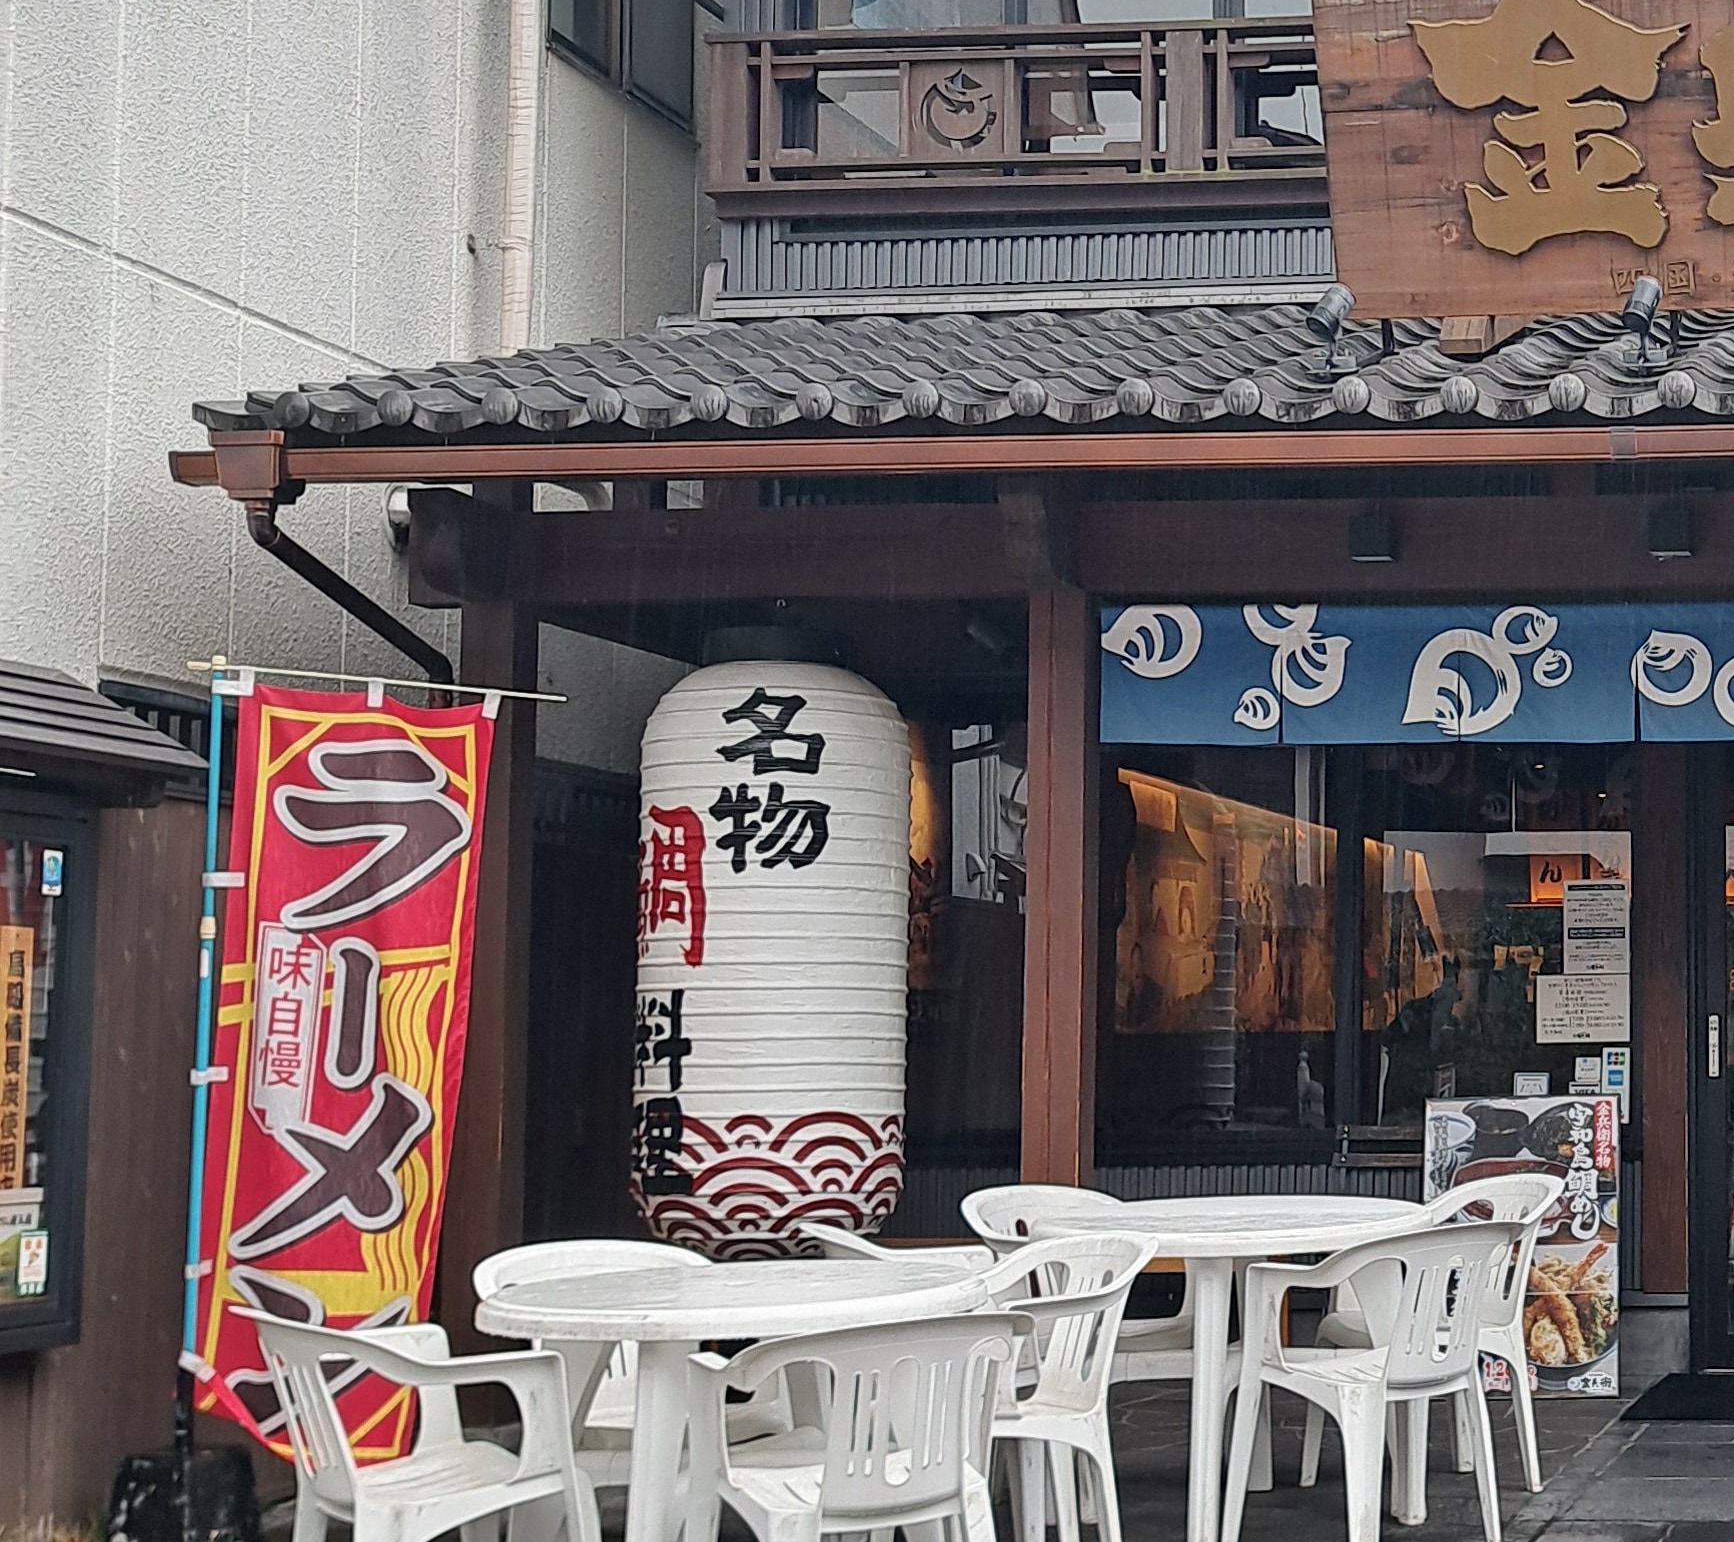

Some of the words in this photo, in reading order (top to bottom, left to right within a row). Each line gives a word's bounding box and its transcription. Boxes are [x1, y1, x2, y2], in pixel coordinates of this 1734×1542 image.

[709, 687, 831, 874] 名物
[258, 943, 314, 1091] 味自慢
[1595, 1101, 1612, 1169] 金兵衛名物
